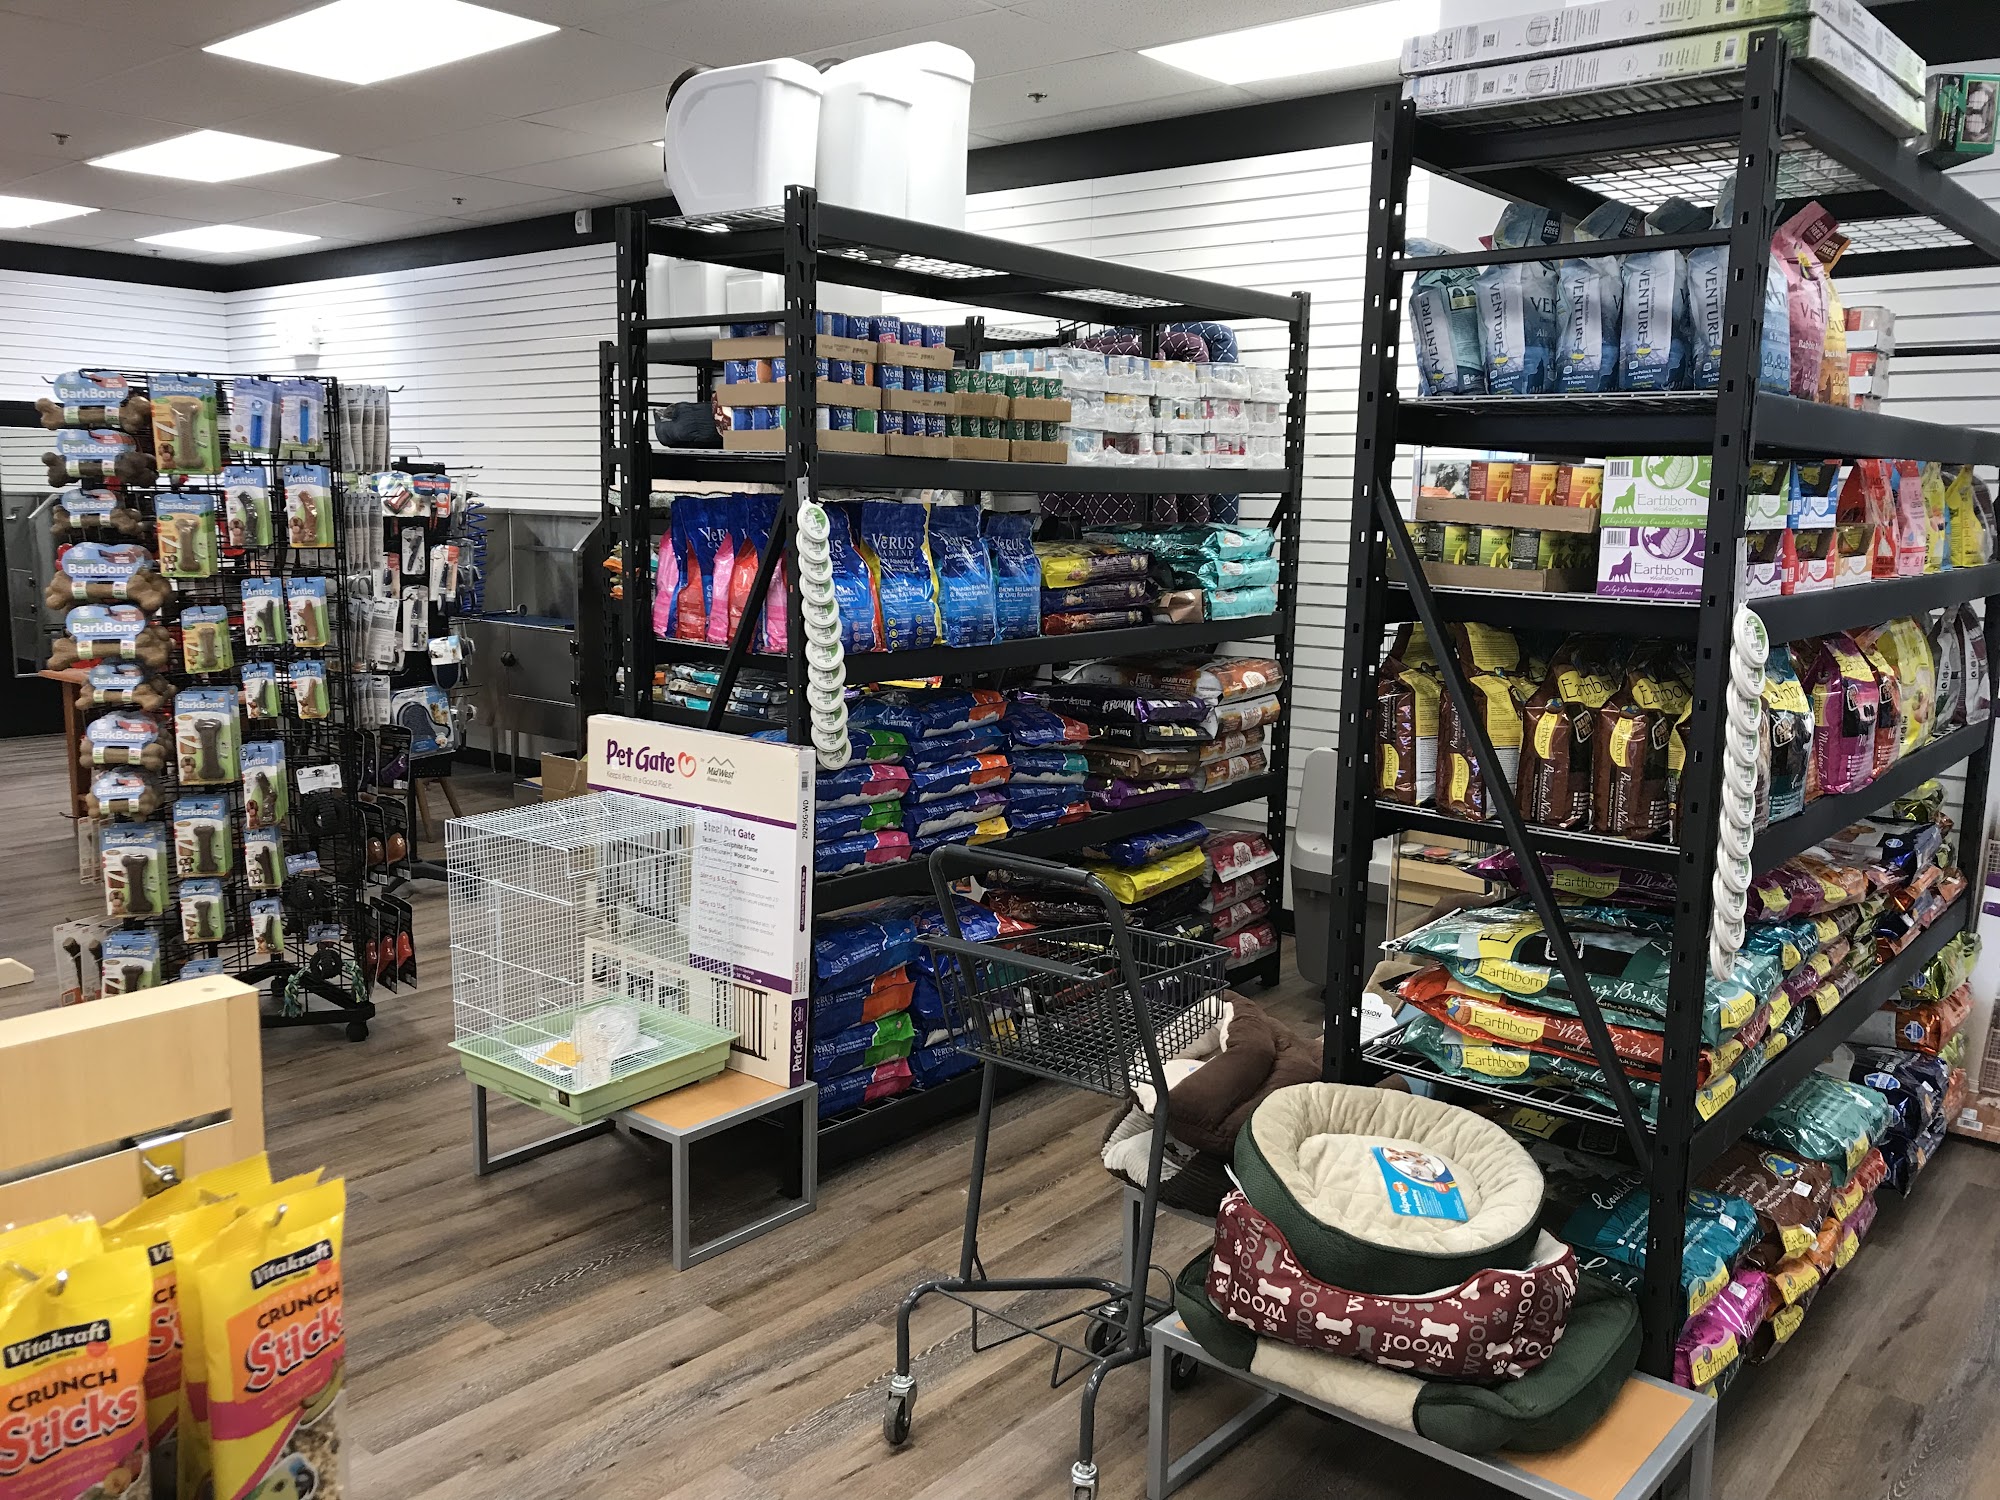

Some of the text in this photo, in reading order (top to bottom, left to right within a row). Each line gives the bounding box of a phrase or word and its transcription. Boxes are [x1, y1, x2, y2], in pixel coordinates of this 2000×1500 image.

[1543, 226, 1559, 236] FREE
[1819, 244, 1836, 256] FREE
[1574, 276, 1586, 347] VENTURE
[1638, 269, 1650, 342] VENTURE
[1705, 266, 1720, 342] VENTURE
[1489, 282, 1504, 351] VENTURE
[1421, 296, 1440, 371] VENTURE
[59, 388, 124, 399] BarkBone
[152, 383, 202, 393] BarkBone
[62, 443, 120, 455] BarkBone
[228, 475, 258, 486] Antler
[288, 474, 317, 484] Antler
[67, 500, 116, 510] BarkBone
[158, 502, 201, 511] BarkBone
[1637, 494, 1697, 506] Earthborn
[68, 563, 134, 575] BarkBone
[1634, 562, 1694, 576] Earthborn
[246, 587, 273, 597] Antler
[290, 587, 315, 596] Antler
[72, 622, 140, 634] BarkBone
[93, 675, 138, 686] BarkBone
[177, 700, 225, 710] BarkBone
[1102, 699, 1135, 715] FROMM
[90, 730, 147, 741] BarkBone
[606, 738, 675, 773] Pet Gate
[707, 767, 735, 778] MidWest
[1385, 746, 1393, 787] Earthborn
[606, 770, 621, 780] Keeps
[622, 773, 632, 782] Pets
[642, 778, 658, 787] Good
[1454, 756, 1463, 800] Earthborn
[176, 808, 219, 817] BarkBone
[105, 835, 153, 845] BarkBone
[738, 828, 756, 841] Gate
[1555, 873, 1616, 890] Earthborn
[1479, 960, 1545, 987] Earthborn
[1474, 1011, 1539, 1038] Earthborn
[1557, 1021, 1591, 1048] Weig
[792, 1029, 803, 1072] Pet Gate
[1466, 1051, 1526, 1069] Earthborn
[1702, 1082, 1735, 1116] Earthborn
[1238, 1215, 1266, 1284] woof
[254, 1243, 331, 1286] Vitakraft
[1785, 1275, 1820, 1301] Earthborn
[257, 1284, 340, 1329] CRUNCH
[1232, 1281, 1287, 1323] woof
[1296, 1281, 1321, 1340] woof
[5, 1323, 109, 1365] Vitakraft
[1380, 1332, 1453, 1359] woof
[1462, 1311, 1487, 1375] woof
[1696, 1343, 1738, 1382] Earthborn
[8, 1369, 117, 1412] CRUNCH
[0, 1387, 138, 1475] Sticks
